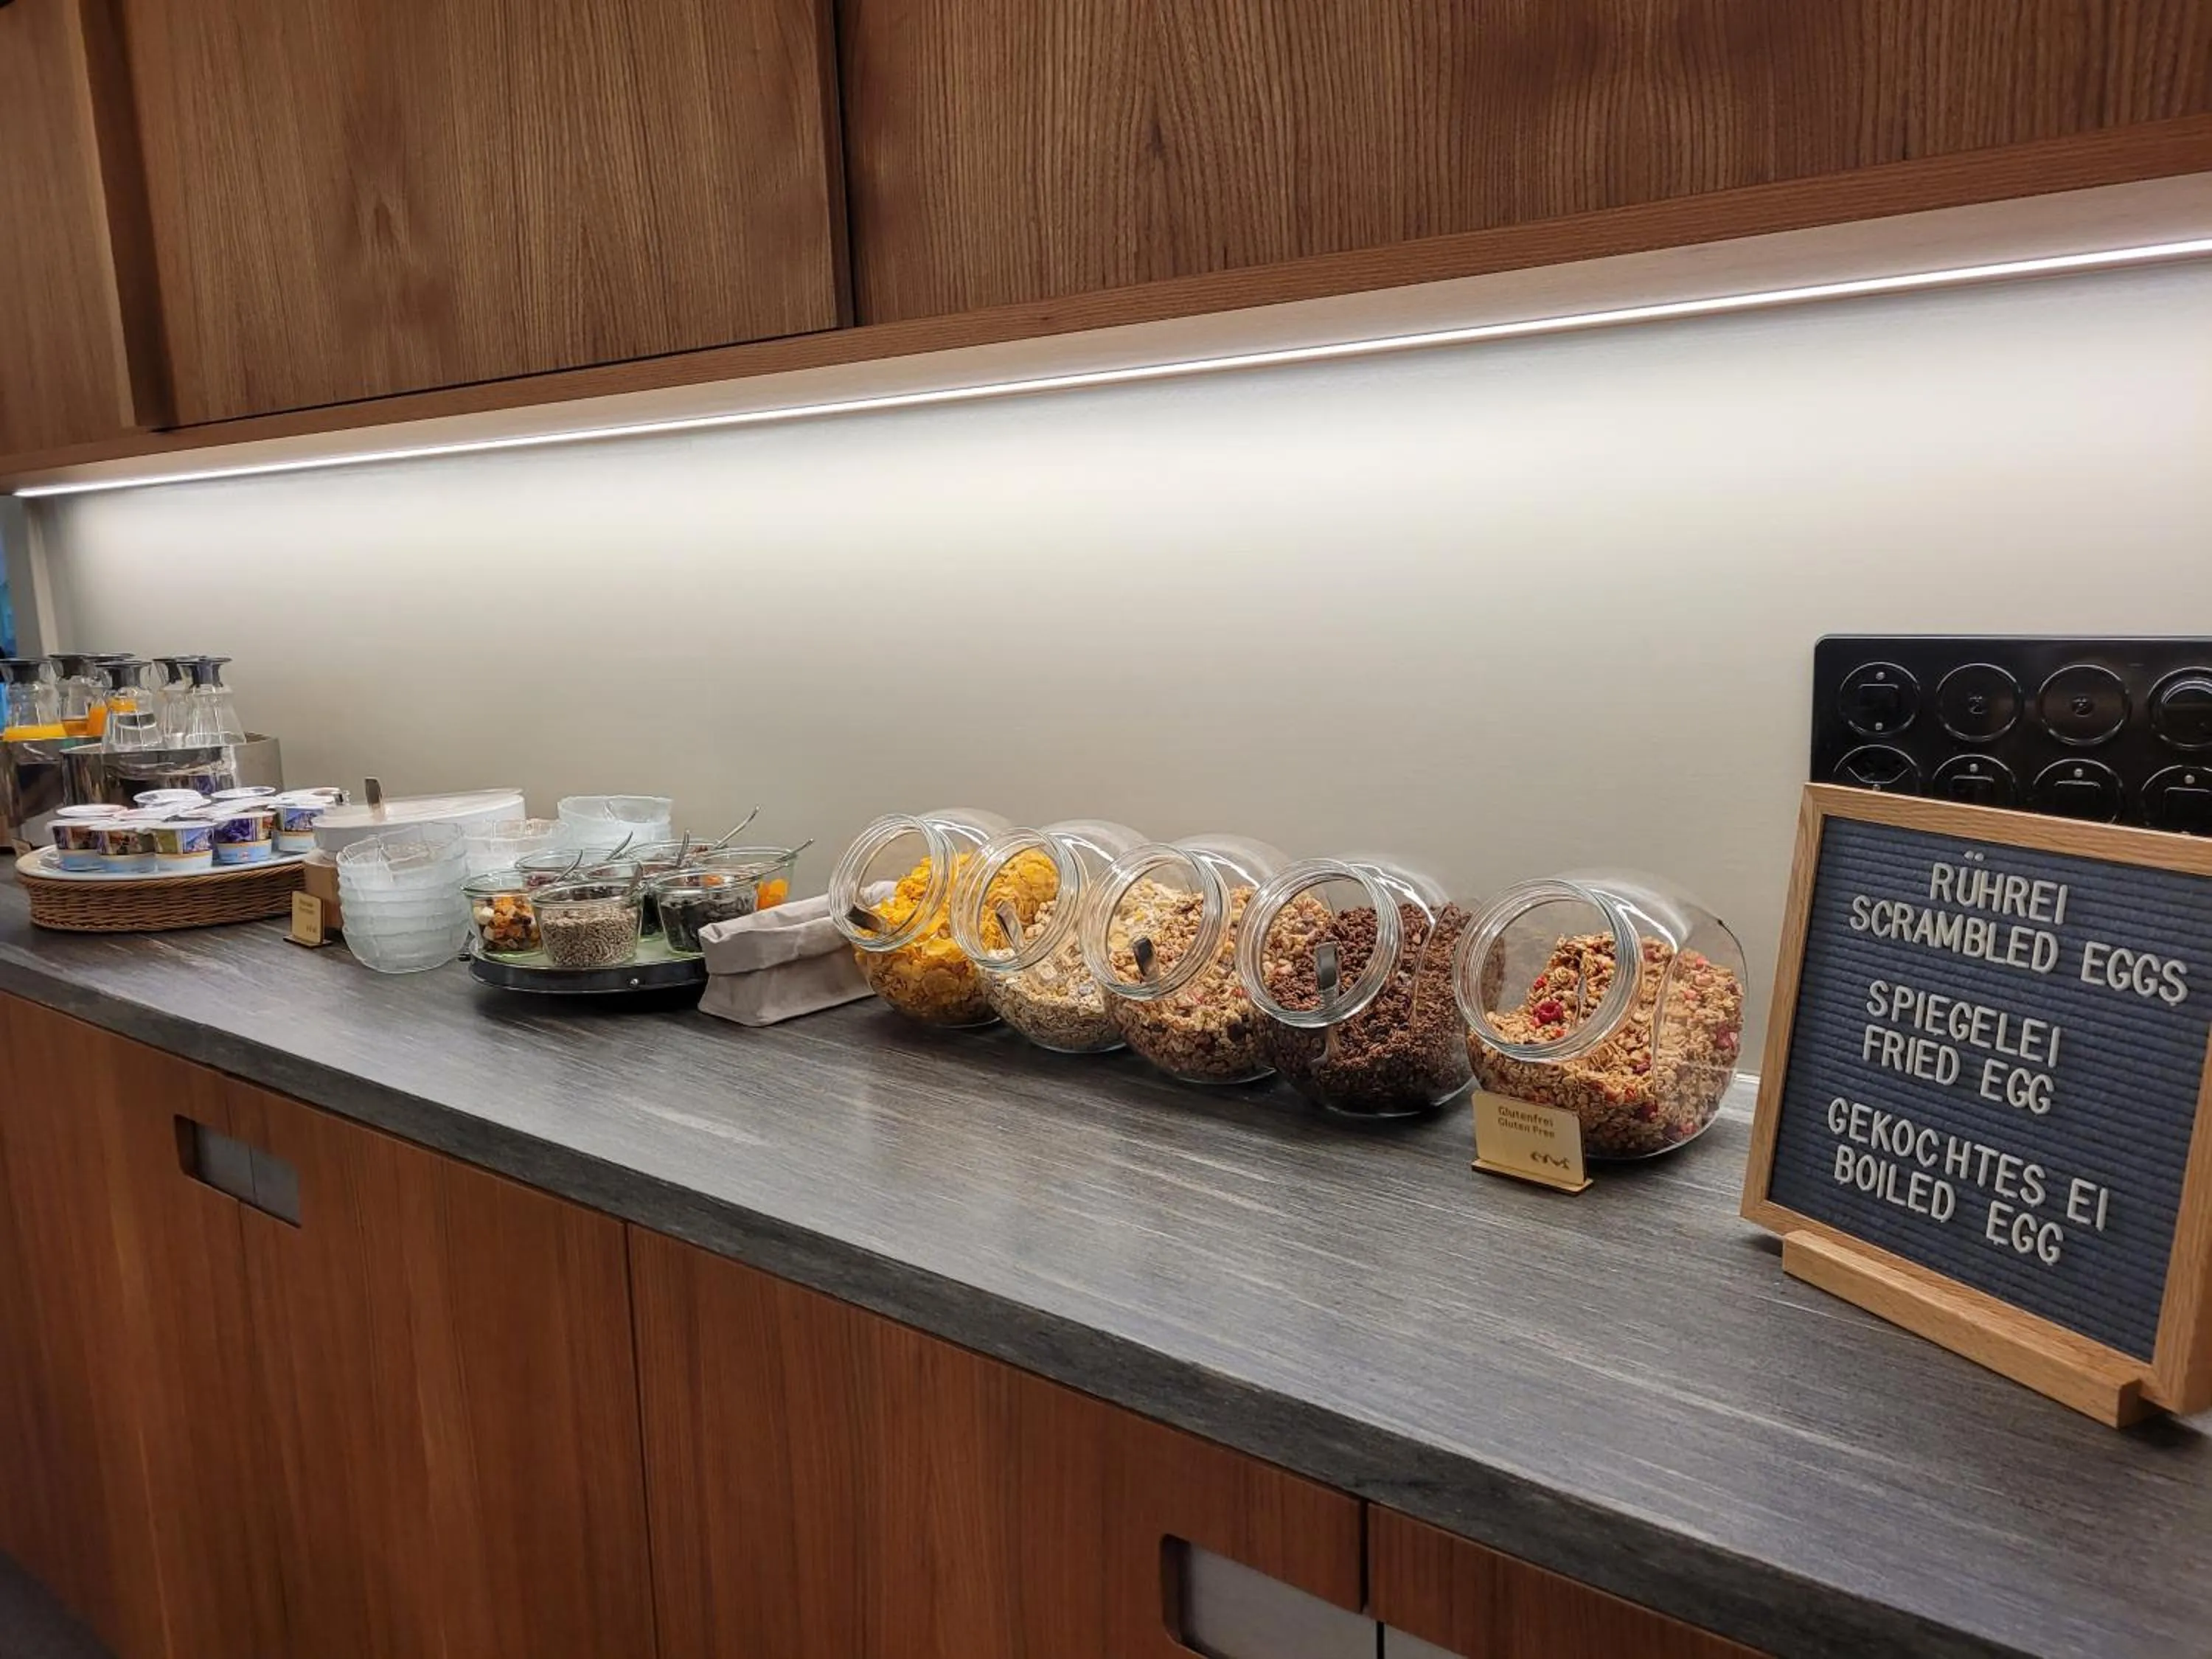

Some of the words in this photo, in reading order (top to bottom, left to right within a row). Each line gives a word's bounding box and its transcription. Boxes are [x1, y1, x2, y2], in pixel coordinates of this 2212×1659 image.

[1930, 851, 2067, 924] RÜHREI
[1849, 895, 2059, 973] SCRAMBLED
[2080, 941, 2188, 1004] EGGS
[1866, 980, 2061, 1068] SPIEGELEI
[1863, 1025, 1960, 1085] FRIED
[1980, 1059, 2056, 1114] EGG
[1498, 1106, 1554, 1126] Glutenfrei
[1498, 1118, 1529, 1133] Gluten
[1534, 1124, 1555, 1138] Free
[1828, 1097, 2046, 1206] GEKOCHTES
[2067, 1178, 2109, 1231] EI
[1834, 1145, 1956, 1223] BOILED
[1986, 1200, 2063, 1265] EGG
